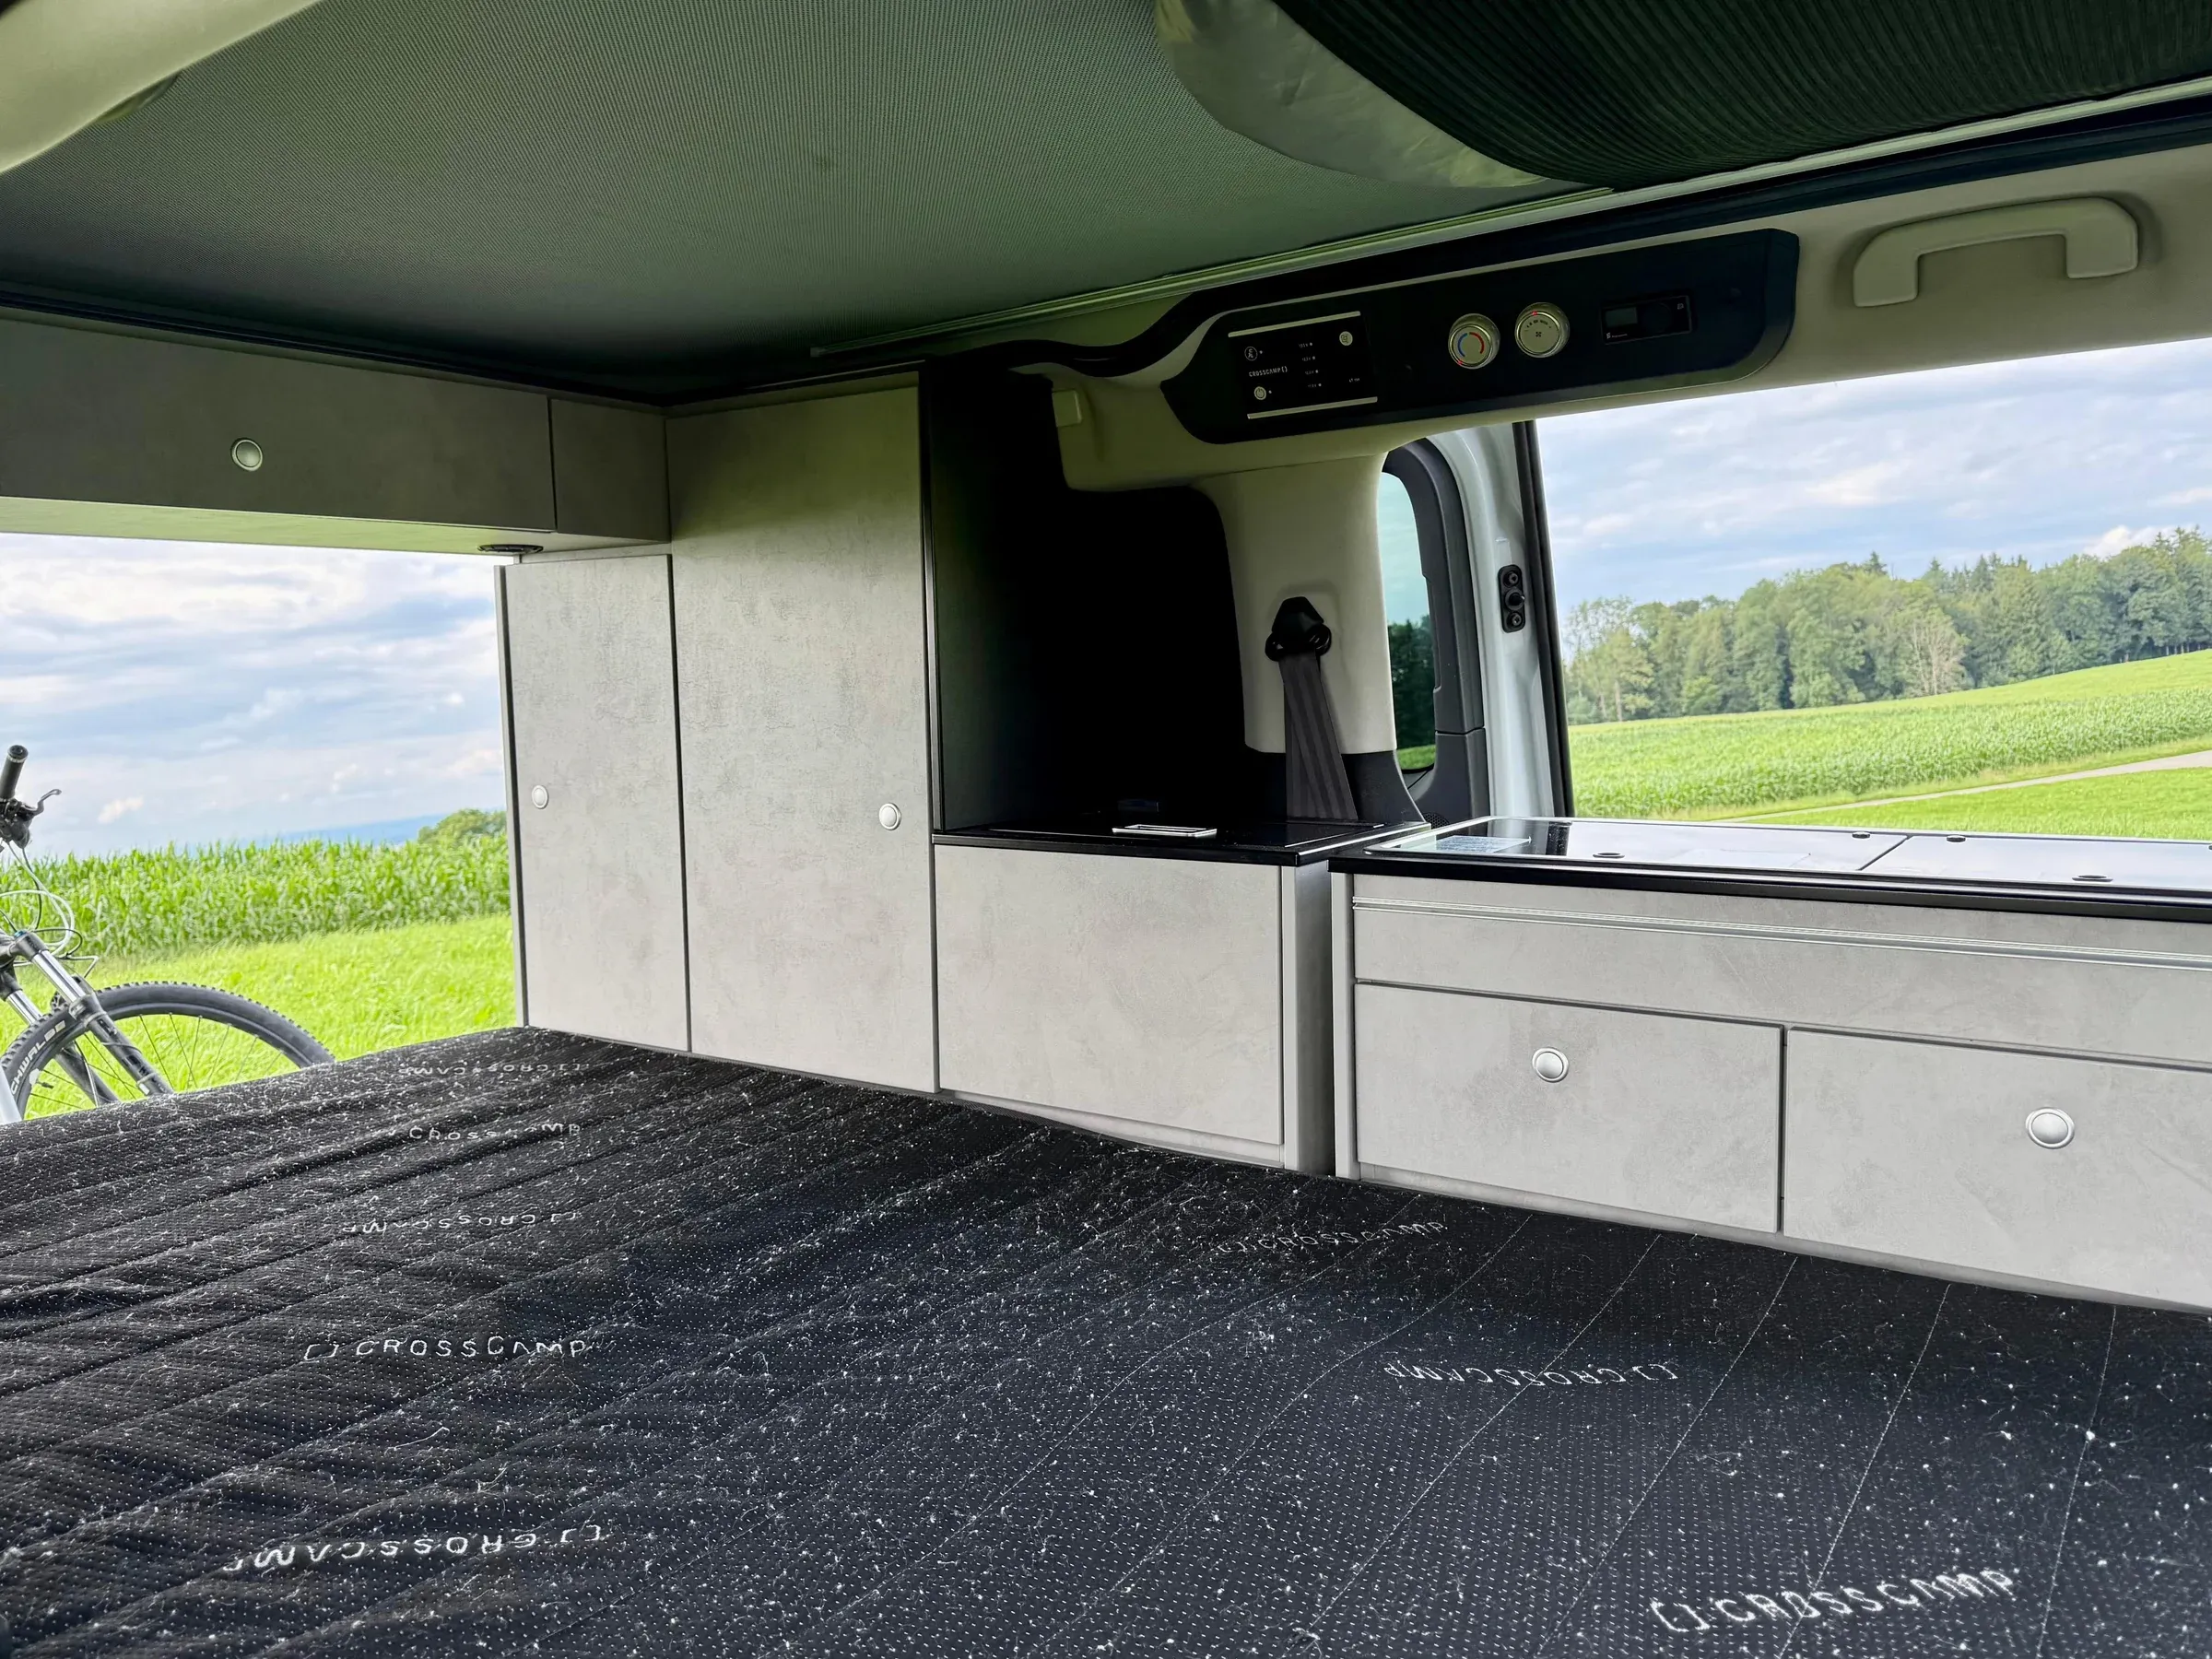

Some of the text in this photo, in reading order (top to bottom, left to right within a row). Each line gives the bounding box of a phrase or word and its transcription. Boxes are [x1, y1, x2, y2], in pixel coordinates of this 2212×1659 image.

[10, 1020, 65, 1095] CHWALBE
[409, 1124, 580, 1141] CROSSAMP
[356, 1336, 585, 1358] CROSSCAMP
[1383, 1363, 1626, 1385] CROSSCAMP
[1714, 1570, 2017, 1622] CROSSCAMP
